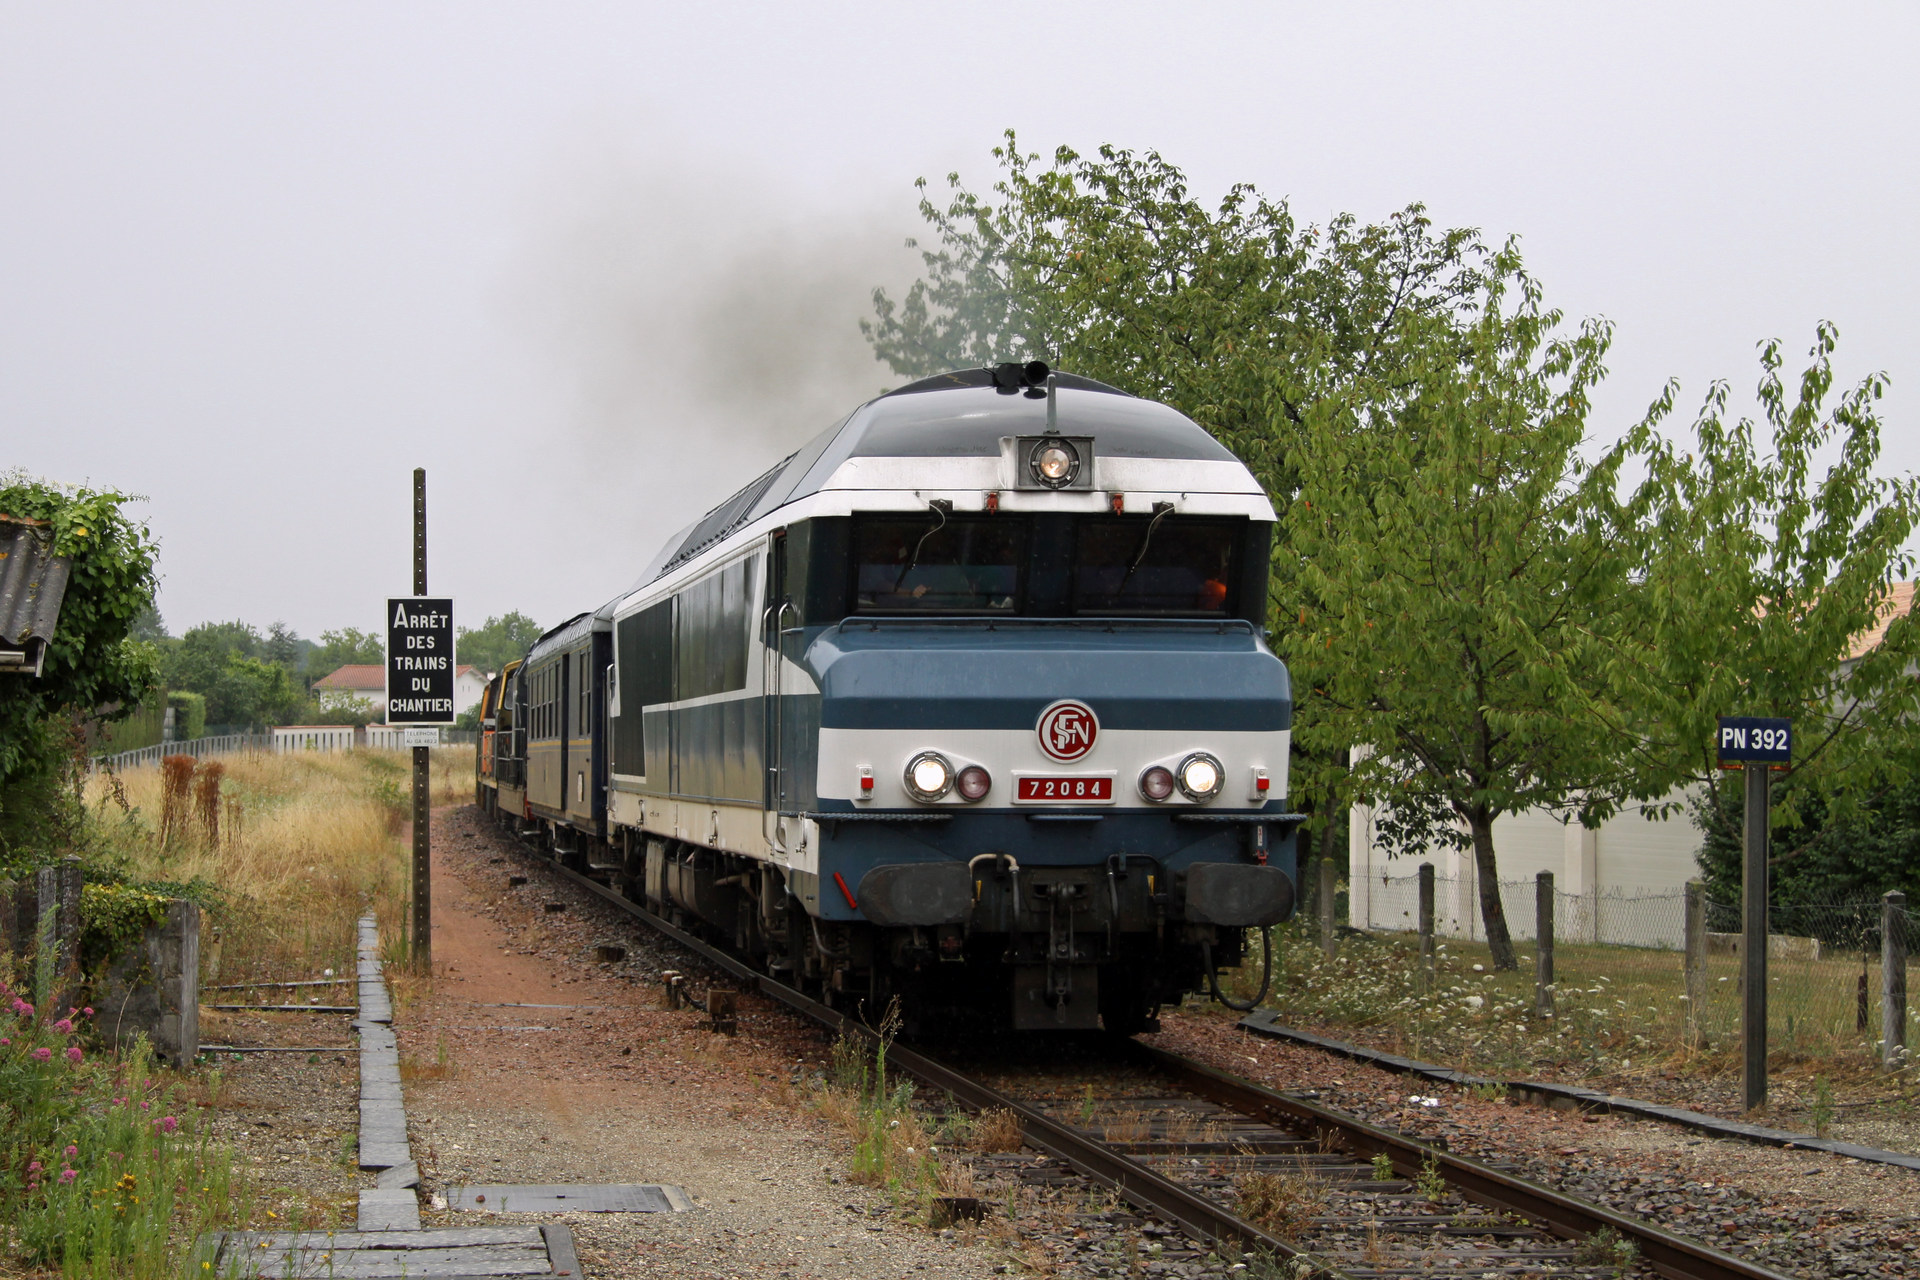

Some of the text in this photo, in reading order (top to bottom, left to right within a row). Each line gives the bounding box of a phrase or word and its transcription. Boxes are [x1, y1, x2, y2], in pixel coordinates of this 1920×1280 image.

[393, 603, 448, 629] ARRÊT
[406, 636, 435, 649] DES
[395, 657, 447, 670] TRAINS
[412, 678, 430, 691] DU
[390, 699, 452, 712] CHANTIER
[1722, 727, 1788, 750] PN 392
[1030, 781, 1100, 796] 72084
[212, 932, 220, 944] 2
